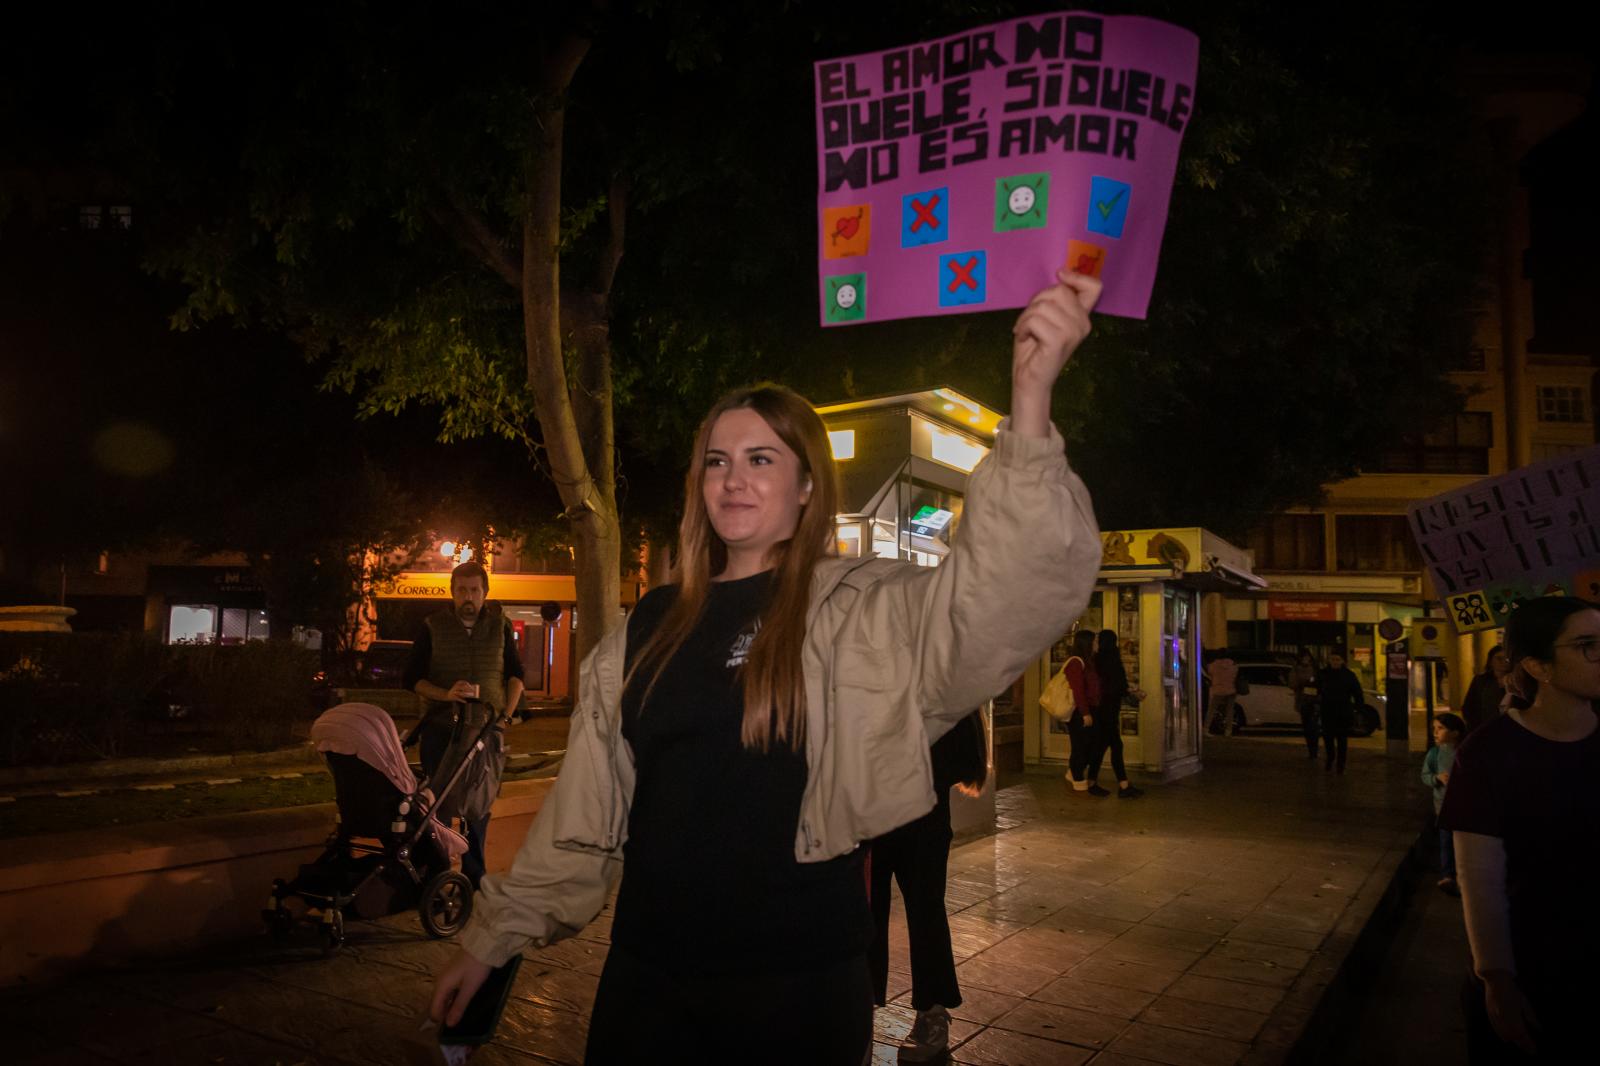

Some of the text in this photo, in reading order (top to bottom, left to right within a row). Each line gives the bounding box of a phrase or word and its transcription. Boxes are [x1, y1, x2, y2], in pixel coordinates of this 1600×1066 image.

[819, 62, 870, 102] EL
[882, 31, 1007, 93] AMOR
[1067, 64, 1192, 133] DUELE
[919, 121, 988, 173] ES
[1000, 114, 1138, 161] AMOR
[397, 584, 447, 595] CORREOS
